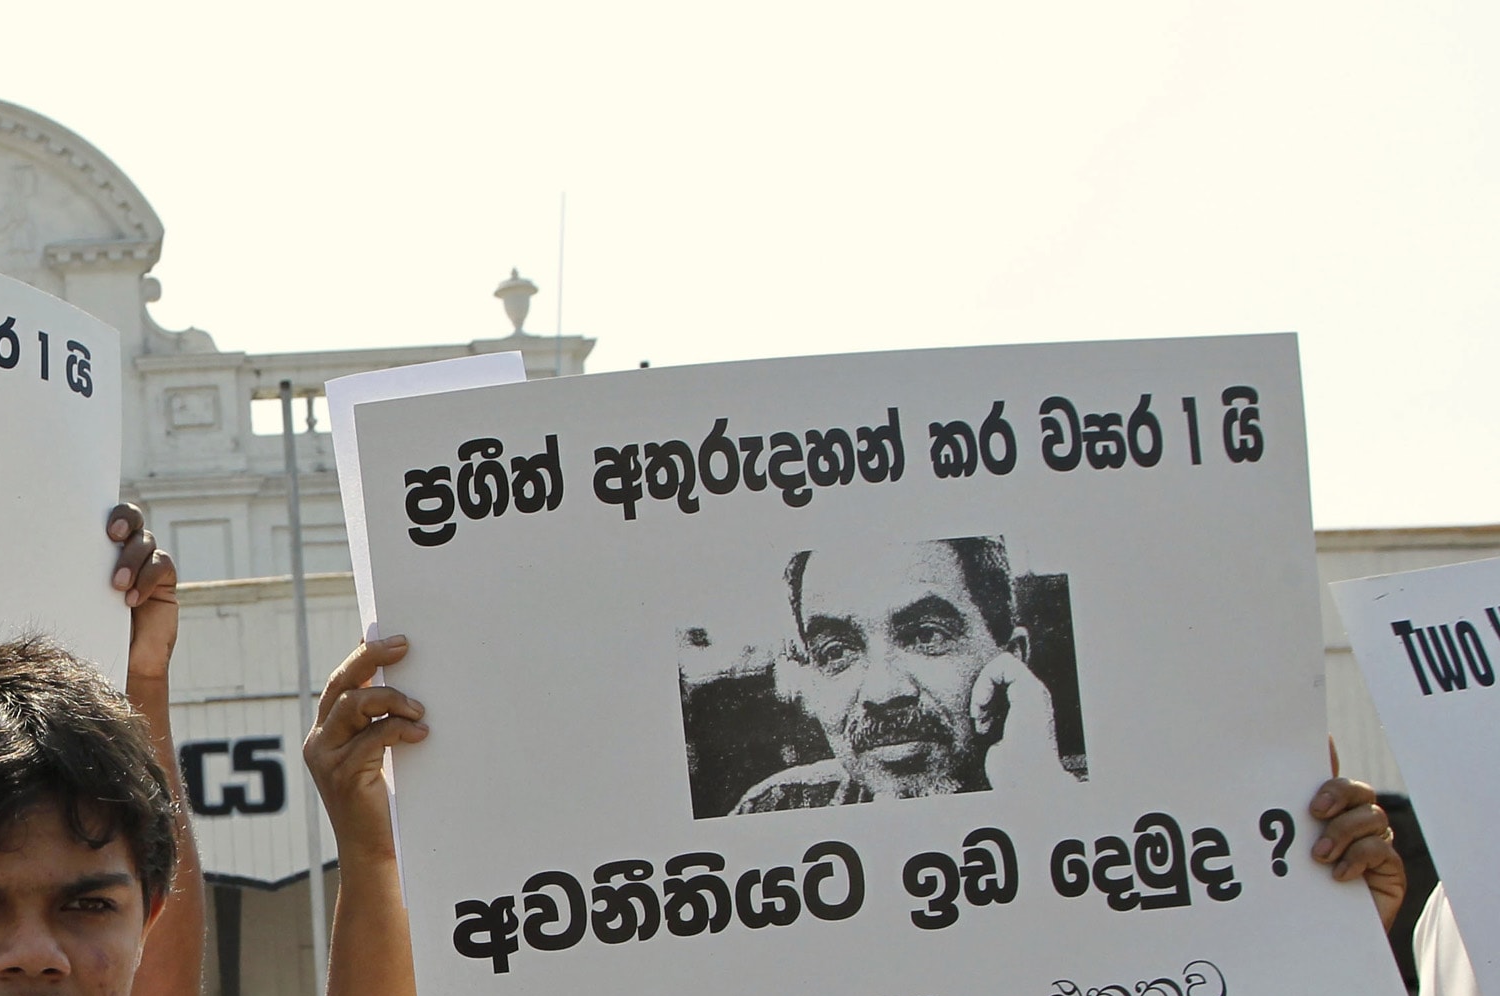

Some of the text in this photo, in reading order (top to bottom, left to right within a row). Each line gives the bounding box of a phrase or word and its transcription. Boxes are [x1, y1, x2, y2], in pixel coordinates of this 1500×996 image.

[66, 340, 92, 398] යි
[593, 407, 905, 520] අතුරුදහන්
[929, 401, 1017, 478] කර
[1039, 394, 1162, 471] වසර
[1222, 386, 1263, 463] යි
[1391, 620, 1495, 695] Two
[453, 809, 1295, 974] අවනීතියට ඉඩ දෙමුද ?
